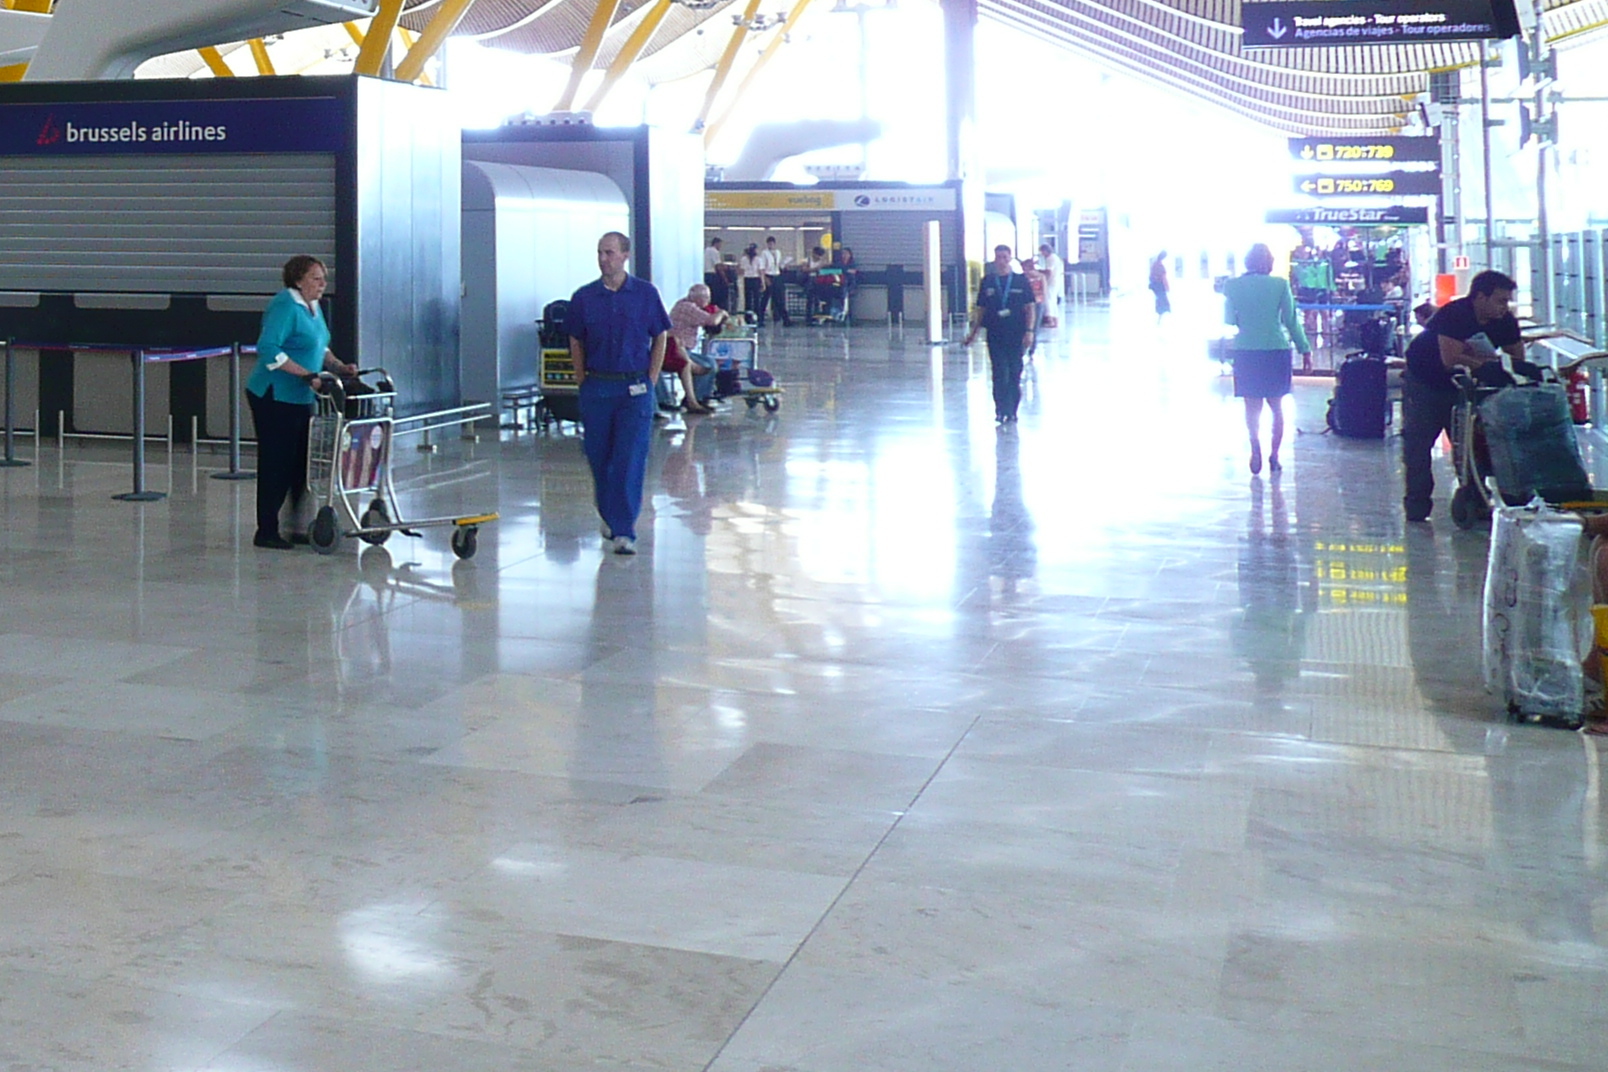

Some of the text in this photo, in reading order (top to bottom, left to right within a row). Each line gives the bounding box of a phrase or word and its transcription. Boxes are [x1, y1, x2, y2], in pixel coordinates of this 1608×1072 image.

[1322, 14, 1366, 29] agencies
[1373, 13, 1395, 25] Tour
[1396, 12, 1447, 26] operators
[1294, 25, 1345, 40] Agencias
[1345, 26, 1360, 37] de
[1361, 24, 1394, 39] viajes
[1401, 23, 1426, 35] Tour
[1426, 22, 1492, 37] operadores
[66, 119, 227, 143] brussels airlines
[1336, 179, 1363, 193] 750
[1312, 208, 1387, 222] TrueStar
